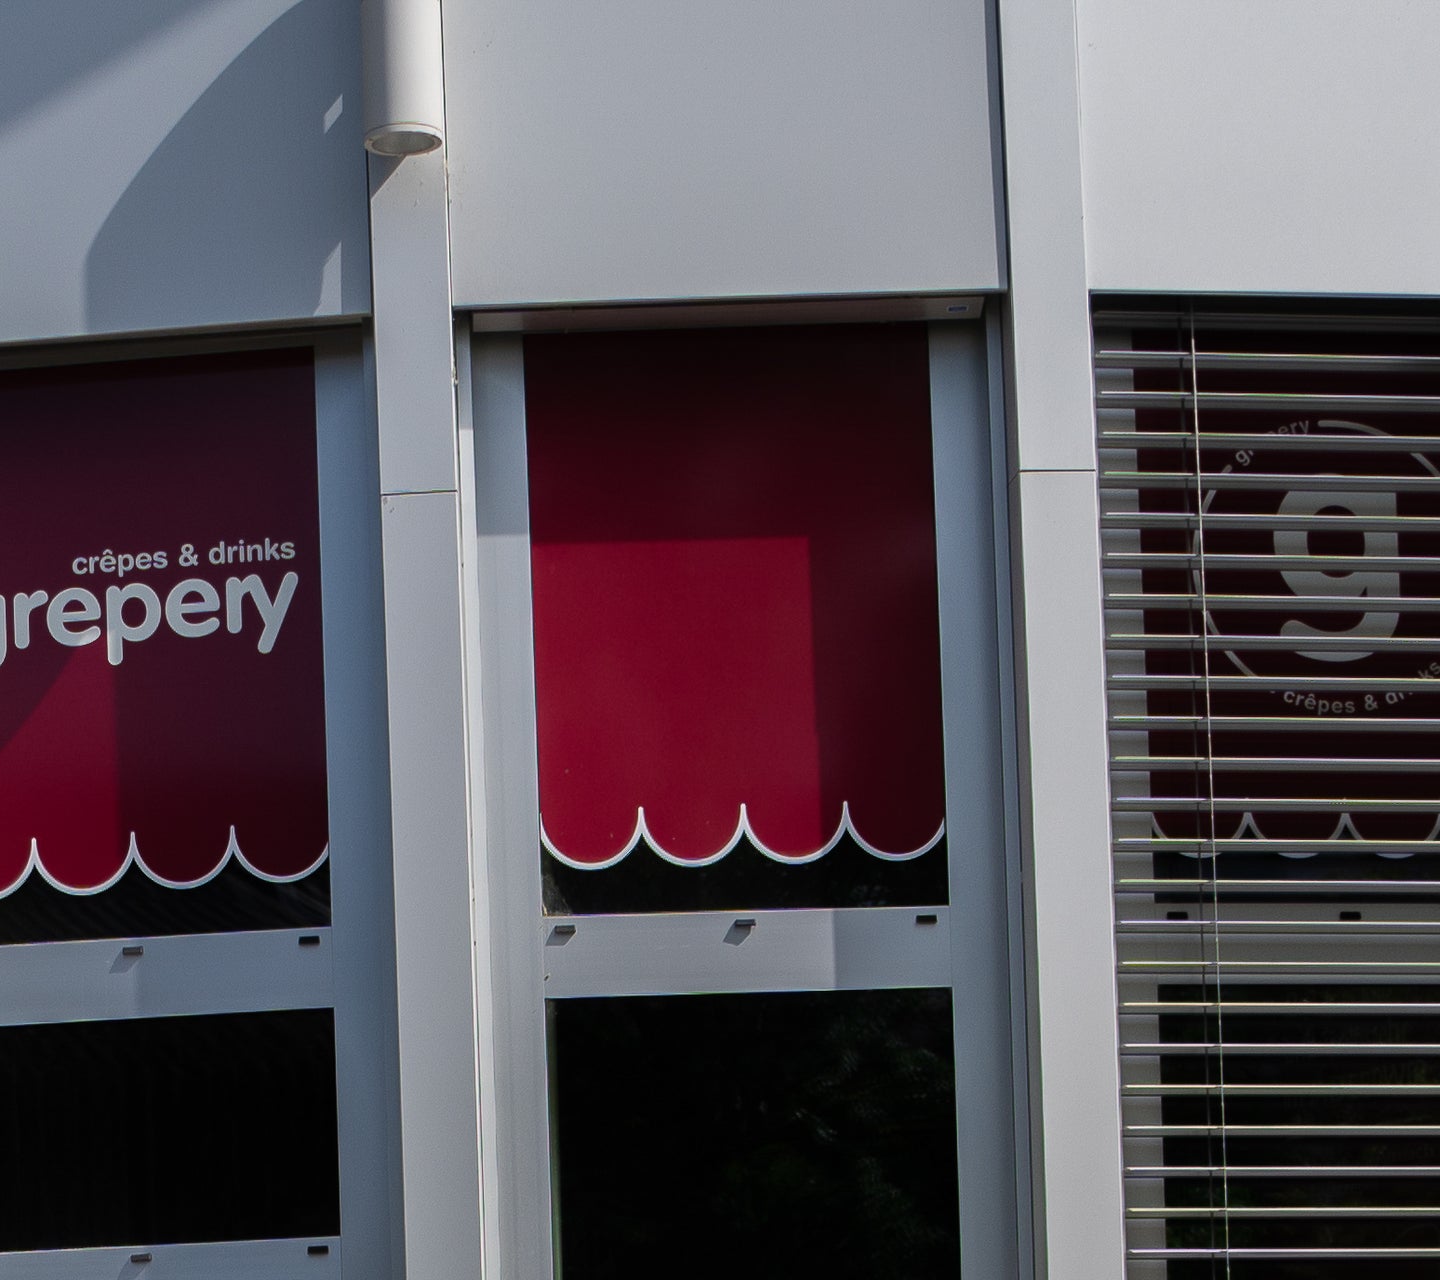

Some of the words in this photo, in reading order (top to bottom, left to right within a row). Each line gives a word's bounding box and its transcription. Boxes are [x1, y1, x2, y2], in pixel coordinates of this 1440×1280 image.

[72, 548, 168, 577] crêpes
[178, 543, 199, 567] &
[208, 538, 296, 565] drinks
[1283, 691, 1355, 716] crêpes
[1364, 694, 1378, 711] &
